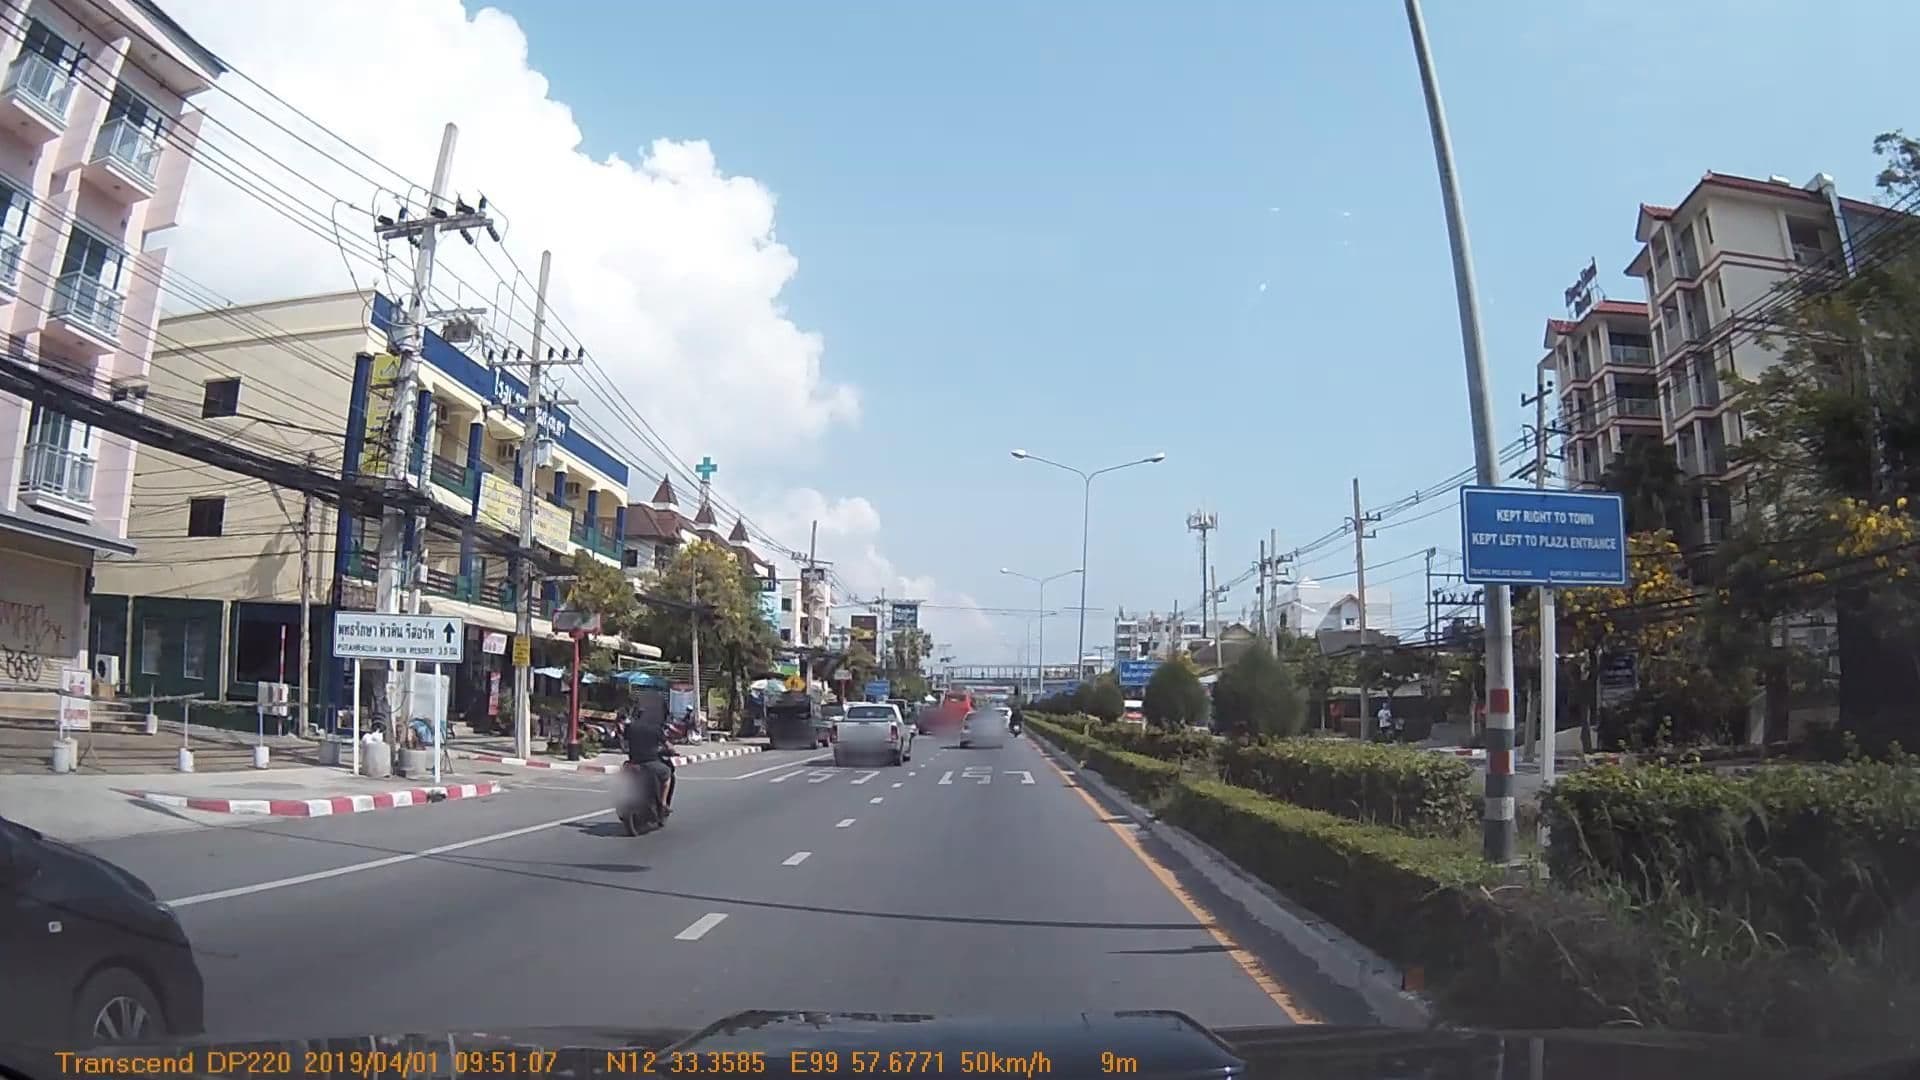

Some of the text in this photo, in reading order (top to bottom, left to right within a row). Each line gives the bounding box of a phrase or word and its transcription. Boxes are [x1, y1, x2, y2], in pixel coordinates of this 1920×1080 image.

[1496, 509, 1594, 525] KEPT RIGHT TO TOWN
[1472, 532, 1616, 550] KEPT LEFT TO PLAZA ENTRANCE
[380, 622, 403, 638] หัวหิน
